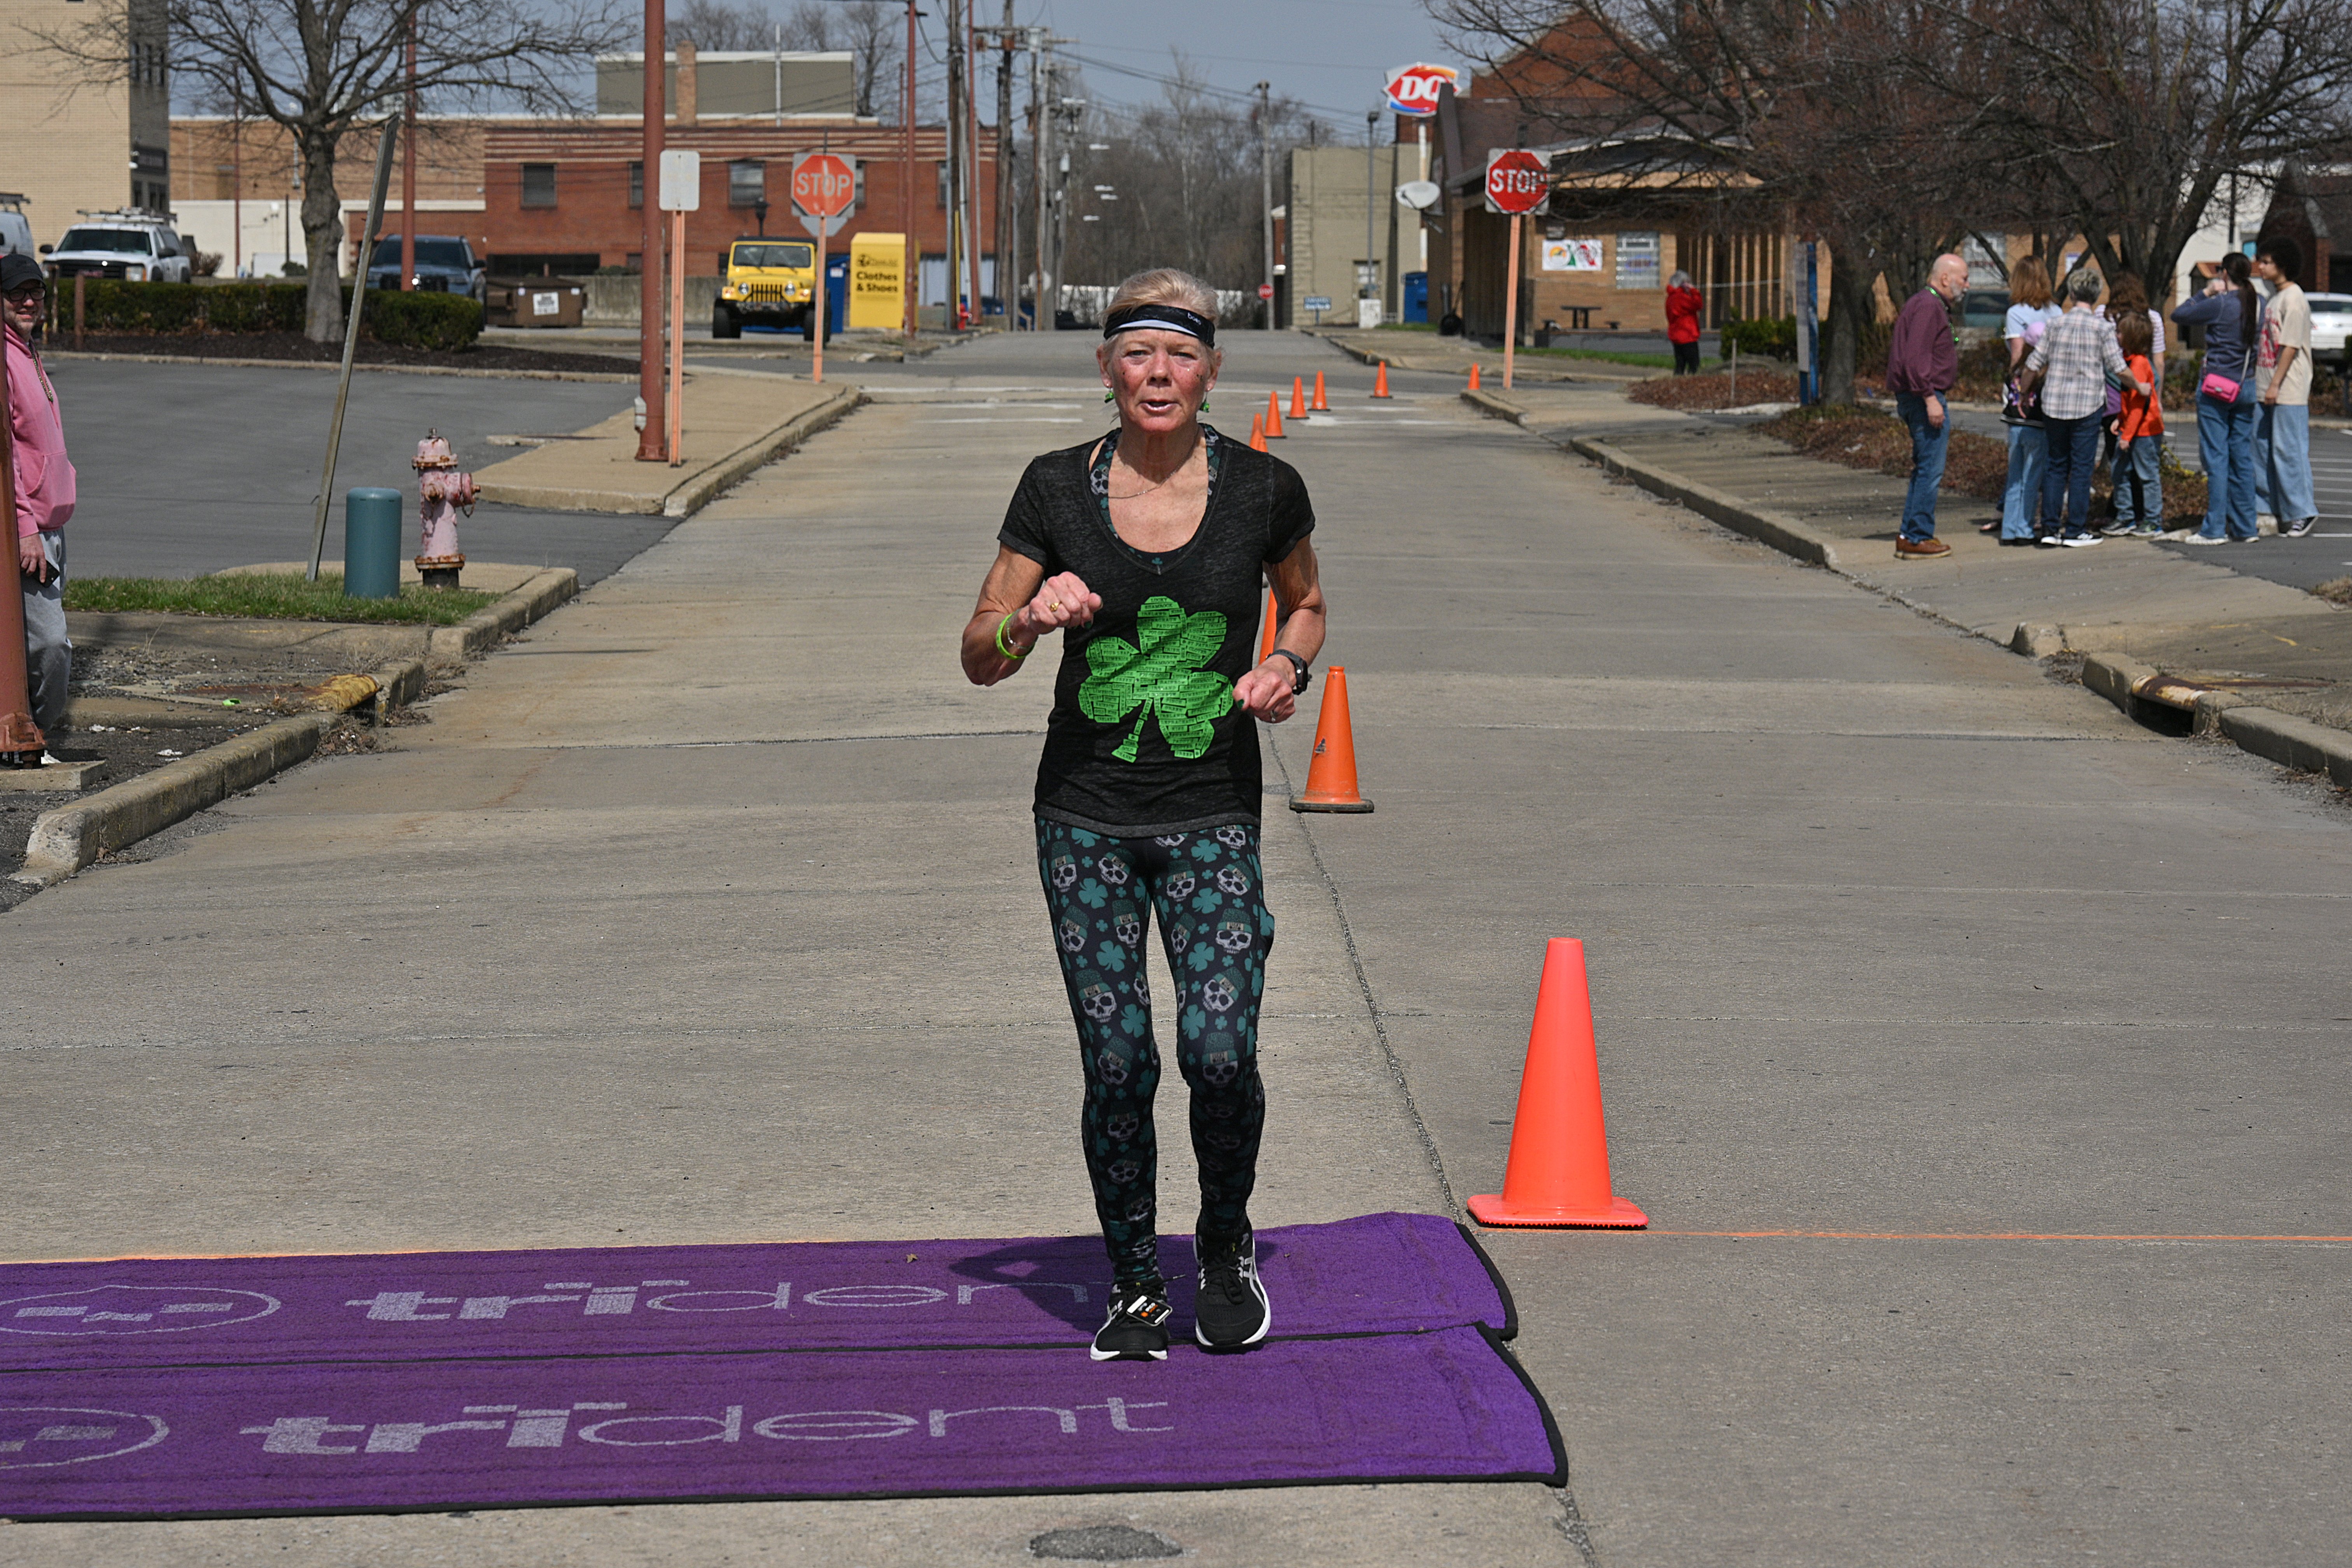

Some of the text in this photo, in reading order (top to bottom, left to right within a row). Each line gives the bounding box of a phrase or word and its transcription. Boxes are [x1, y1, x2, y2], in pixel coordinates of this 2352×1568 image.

[1398, 75, 1446, 102] DQ
[796, 173, 850, 197] STOP
[857, 271, 898, 280] Clothes
[857, 283, 898, 292] & Shoes
[345, 1279, 1111, 1321] triden
[240, 1397, 1174, 1454] trident
